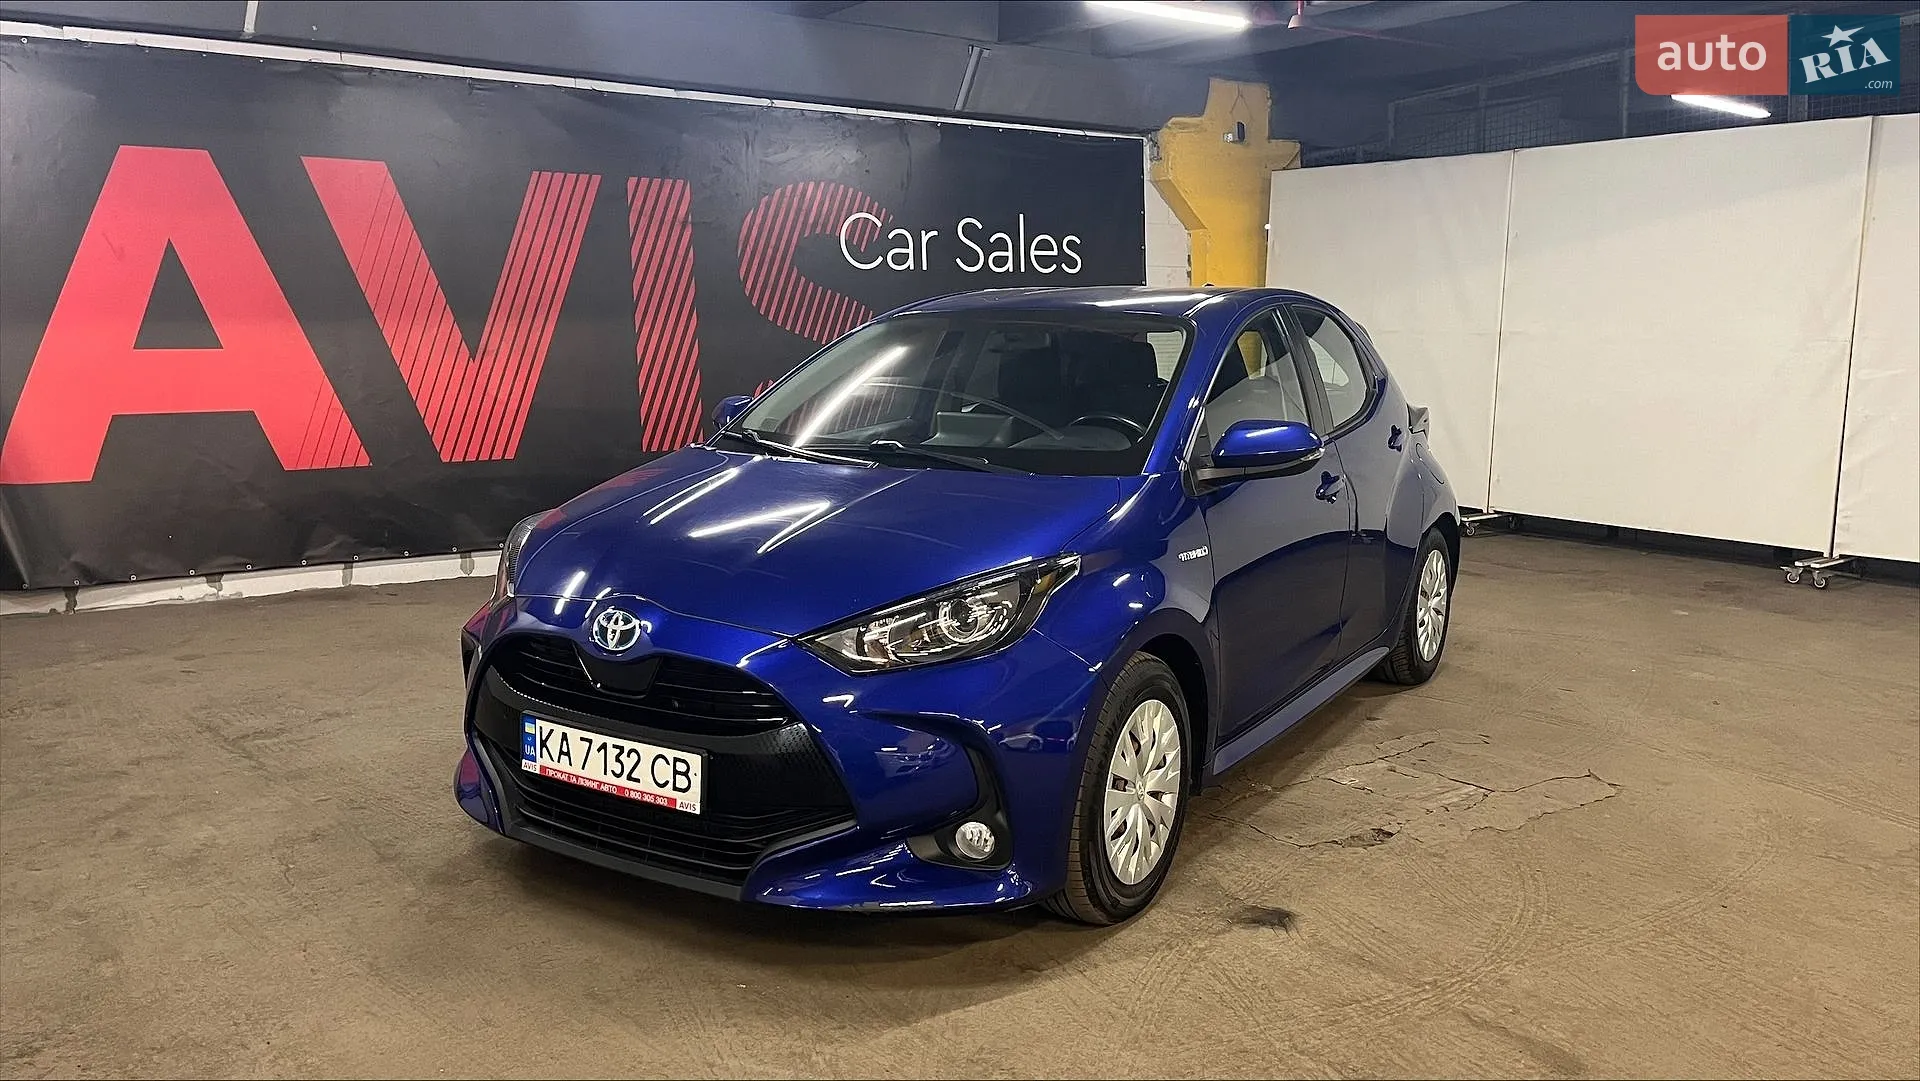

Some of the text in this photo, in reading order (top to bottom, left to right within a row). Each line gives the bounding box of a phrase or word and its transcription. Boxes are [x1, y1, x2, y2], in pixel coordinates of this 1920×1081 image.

[839, 212, 1082, 274] Car Sales
[0, 145, 893, 483] AVIS
[524, 763, 537, 771] AVIS
[525, 745, 535, 756] UA
[539, 726, 692, 794] KA 7132 CB
[546, 769, 568, 780] ПРОКАТ
[600, 784, 617, 793] АВТО
[624, 788, 629, 797] 0
[630, 791, 642, 799] 800
[643, 794, 655, 802] 305
[656, 797, 668, 805] 303
[679, 802, 697, 811] AVIS
